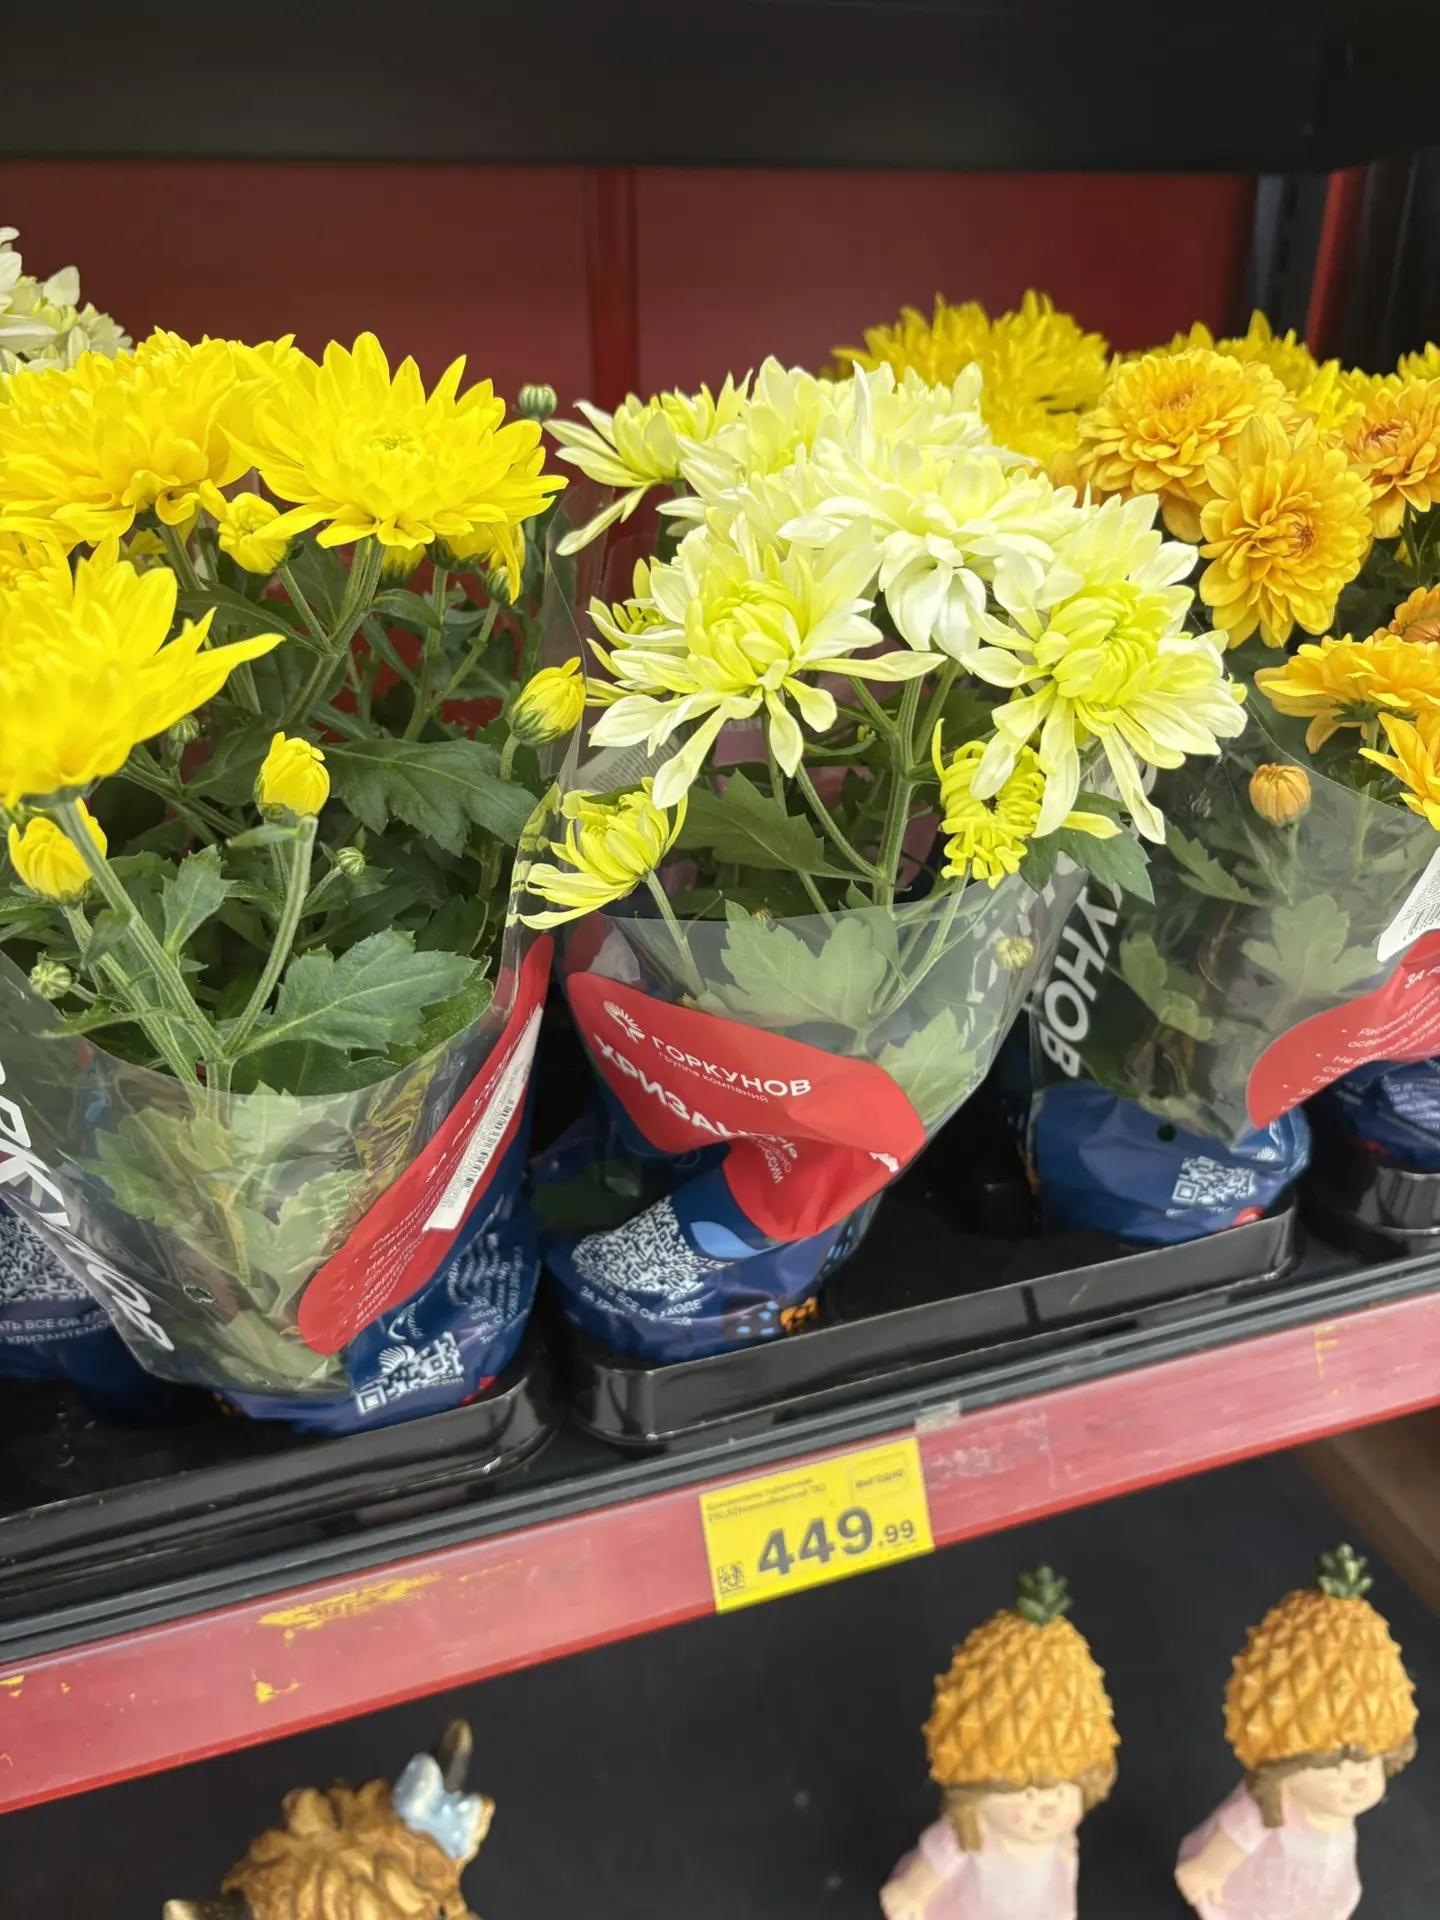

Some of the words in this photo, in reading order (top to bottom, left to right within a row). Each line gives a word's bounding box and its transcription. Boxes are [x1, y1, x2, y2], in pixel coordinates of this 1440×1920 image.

[652, 1035, 812, 1097] ГОРКУНОВ
[658, 1051, 700, 1078] группа
[702, 1073, 770, 1104] компаний
[616, 1292, 641, 1314] ВСЕ
[757, 1505, 874, 1577] 449
